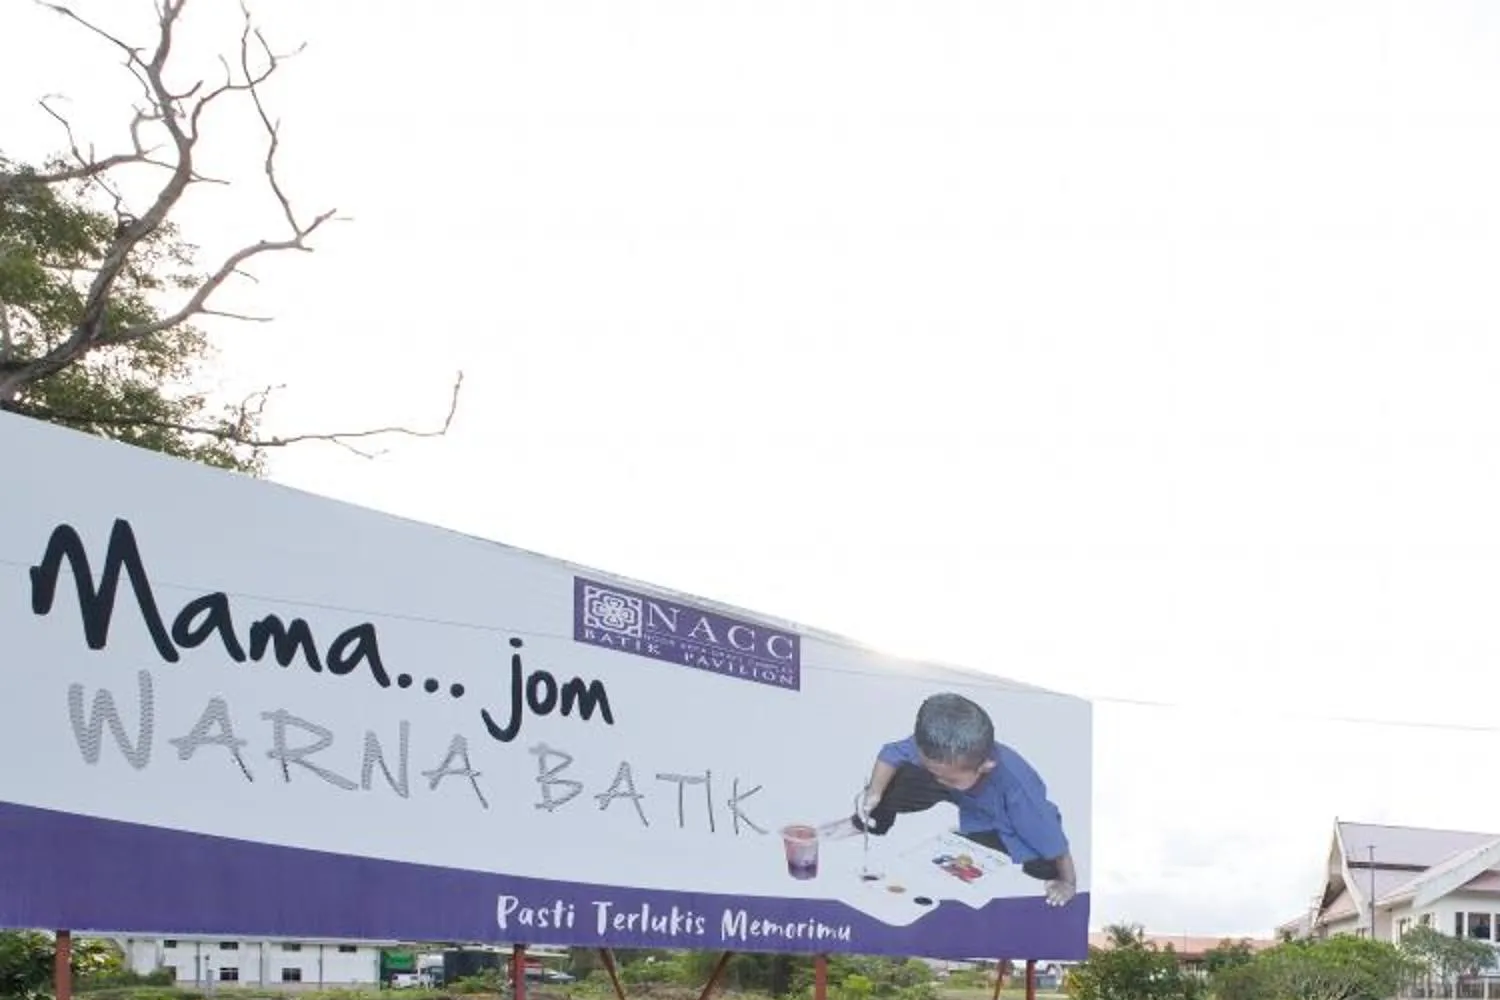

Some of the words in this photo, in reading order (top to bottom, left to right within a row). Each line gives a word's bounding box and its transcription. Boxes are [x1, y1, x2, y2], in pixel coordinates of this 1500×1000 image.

[30, 517, 465, 699] Mama...
[481, 636, 613, 744] jom
[584, 627, 660, 655] BATIK
[684, 651, 793, 685] PAVILION
[647, 602, 793, 661] NACC
[68, 669, 489, 810] WARNA
[529, 740, 768, 836] BATIK
[497, 895, 575, 929] Pasti
[592, 901, 705, 936] Terlukis
[721, 907, 852, 942] Memorimu
